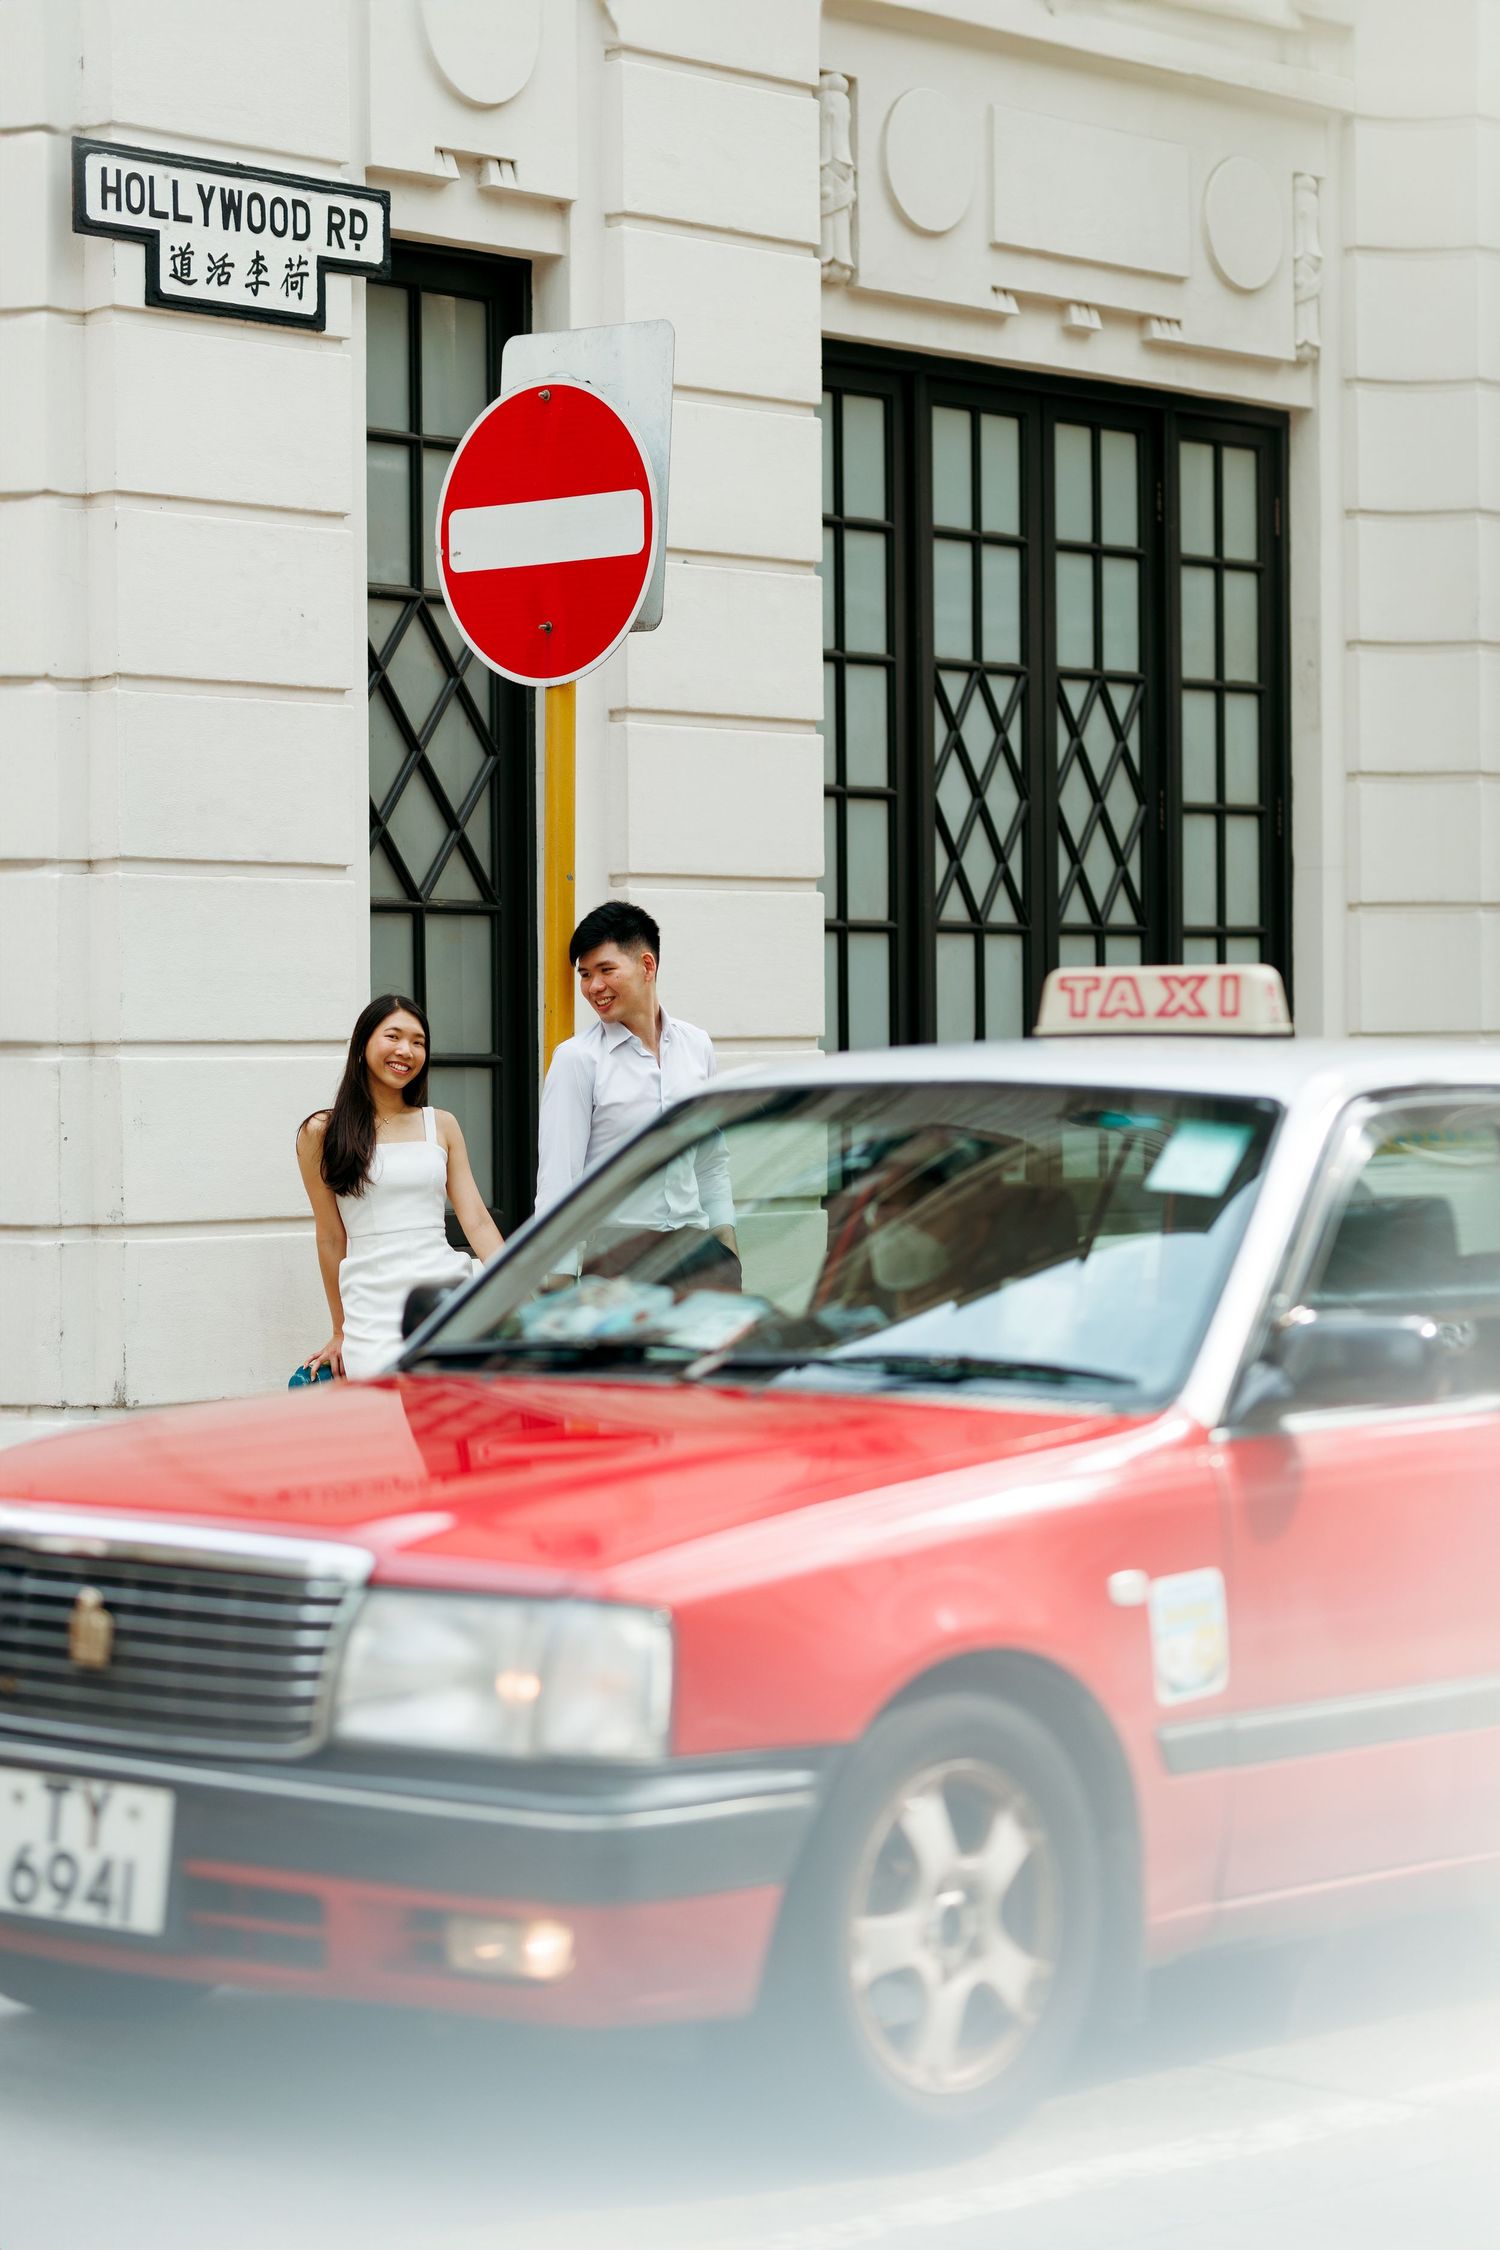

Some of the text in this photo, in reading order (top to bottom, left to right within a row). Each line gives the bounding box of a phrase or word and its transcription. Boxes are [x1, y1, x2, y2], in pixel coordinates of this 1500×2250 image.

[100, 166, 311, 241] HOLLYWOOD
[1058, 974, 1241, 1018] TAXI
[43, 1773, 114, 1850] TY
[8, 1842, 135, 1922] 6941
